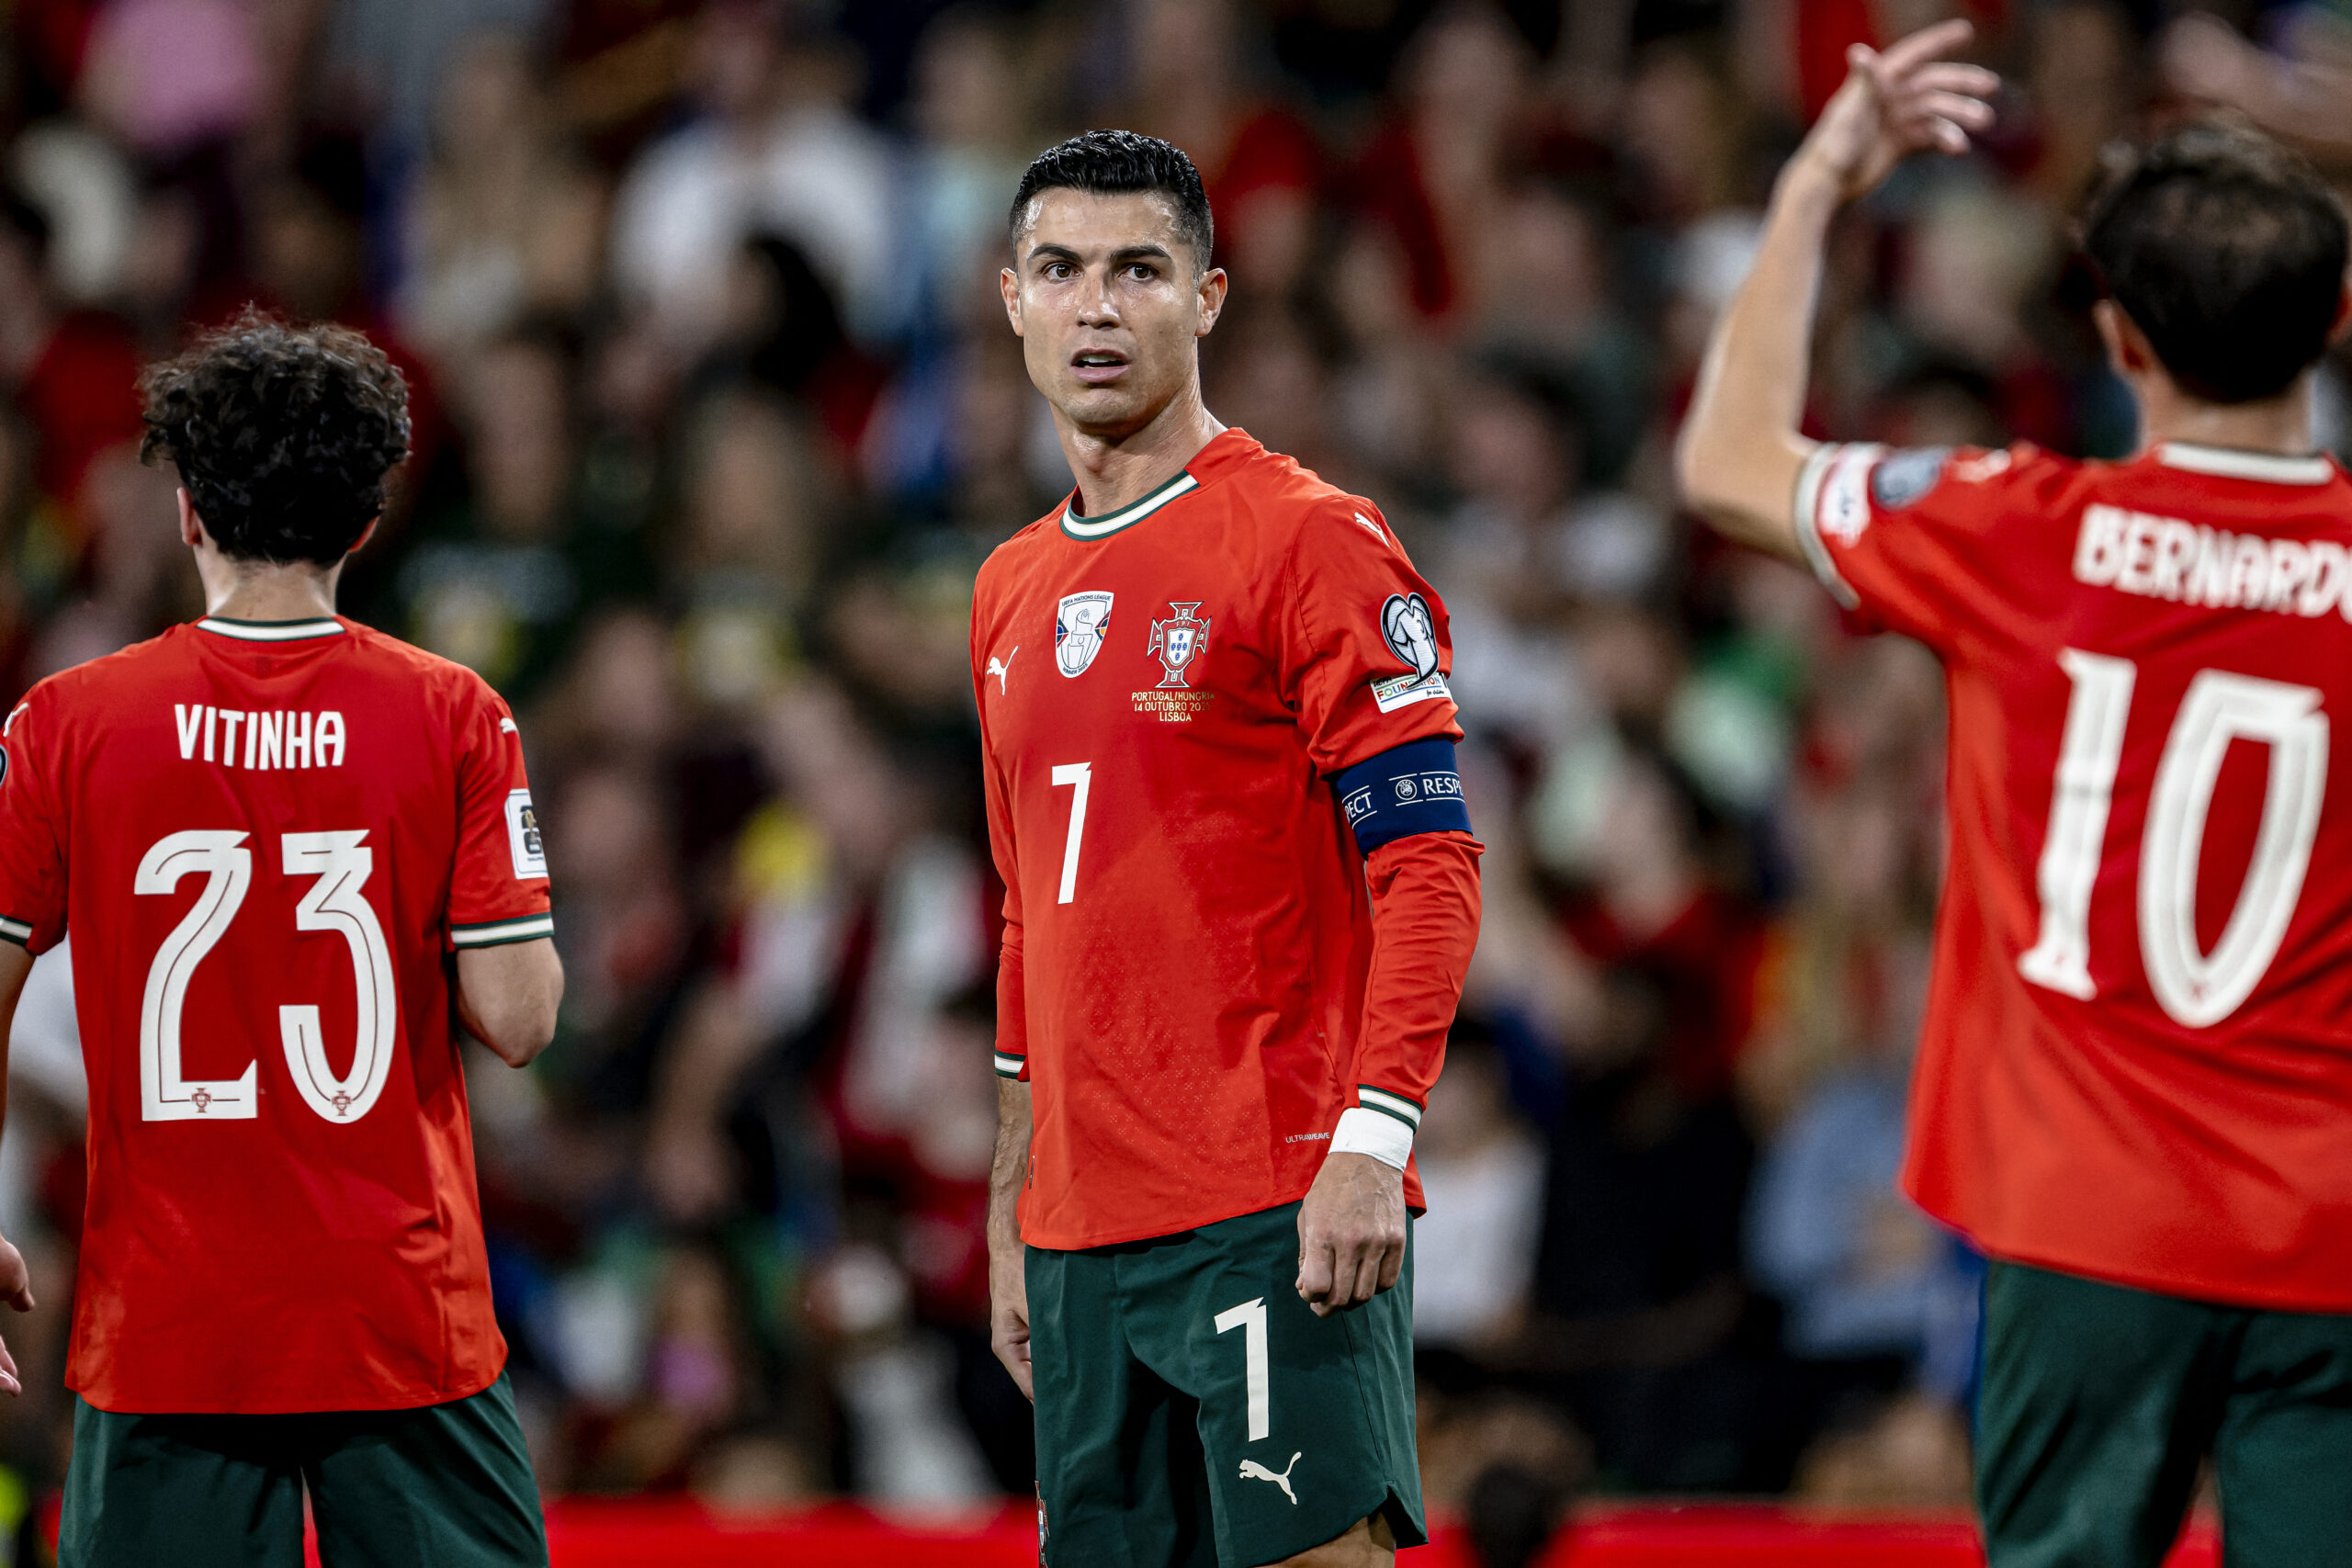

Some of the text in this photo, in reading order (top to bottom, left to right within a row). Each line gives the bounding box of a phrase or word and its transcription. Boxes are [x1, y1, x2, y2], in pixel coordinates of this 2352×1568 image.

[1131, 691, 1216, 702] PORTUGAL/HUNGRIA
[1134, 703, 1143, 712] 14
[1144, 701, 1187, 712] OUTUBRO
[1159, 711, 1193, 722] LISBOA
[175, 704, 345, 771] VITINHA
[1051, 761, 1092, 905] 7
[2018, 647, 2329, 1029] 10
[133, 829, 397, 1124] 23
[1285, 1132, 1330, 1143] ULTRAWEAVE
[1214, 1296, 1270, 1443] 7
